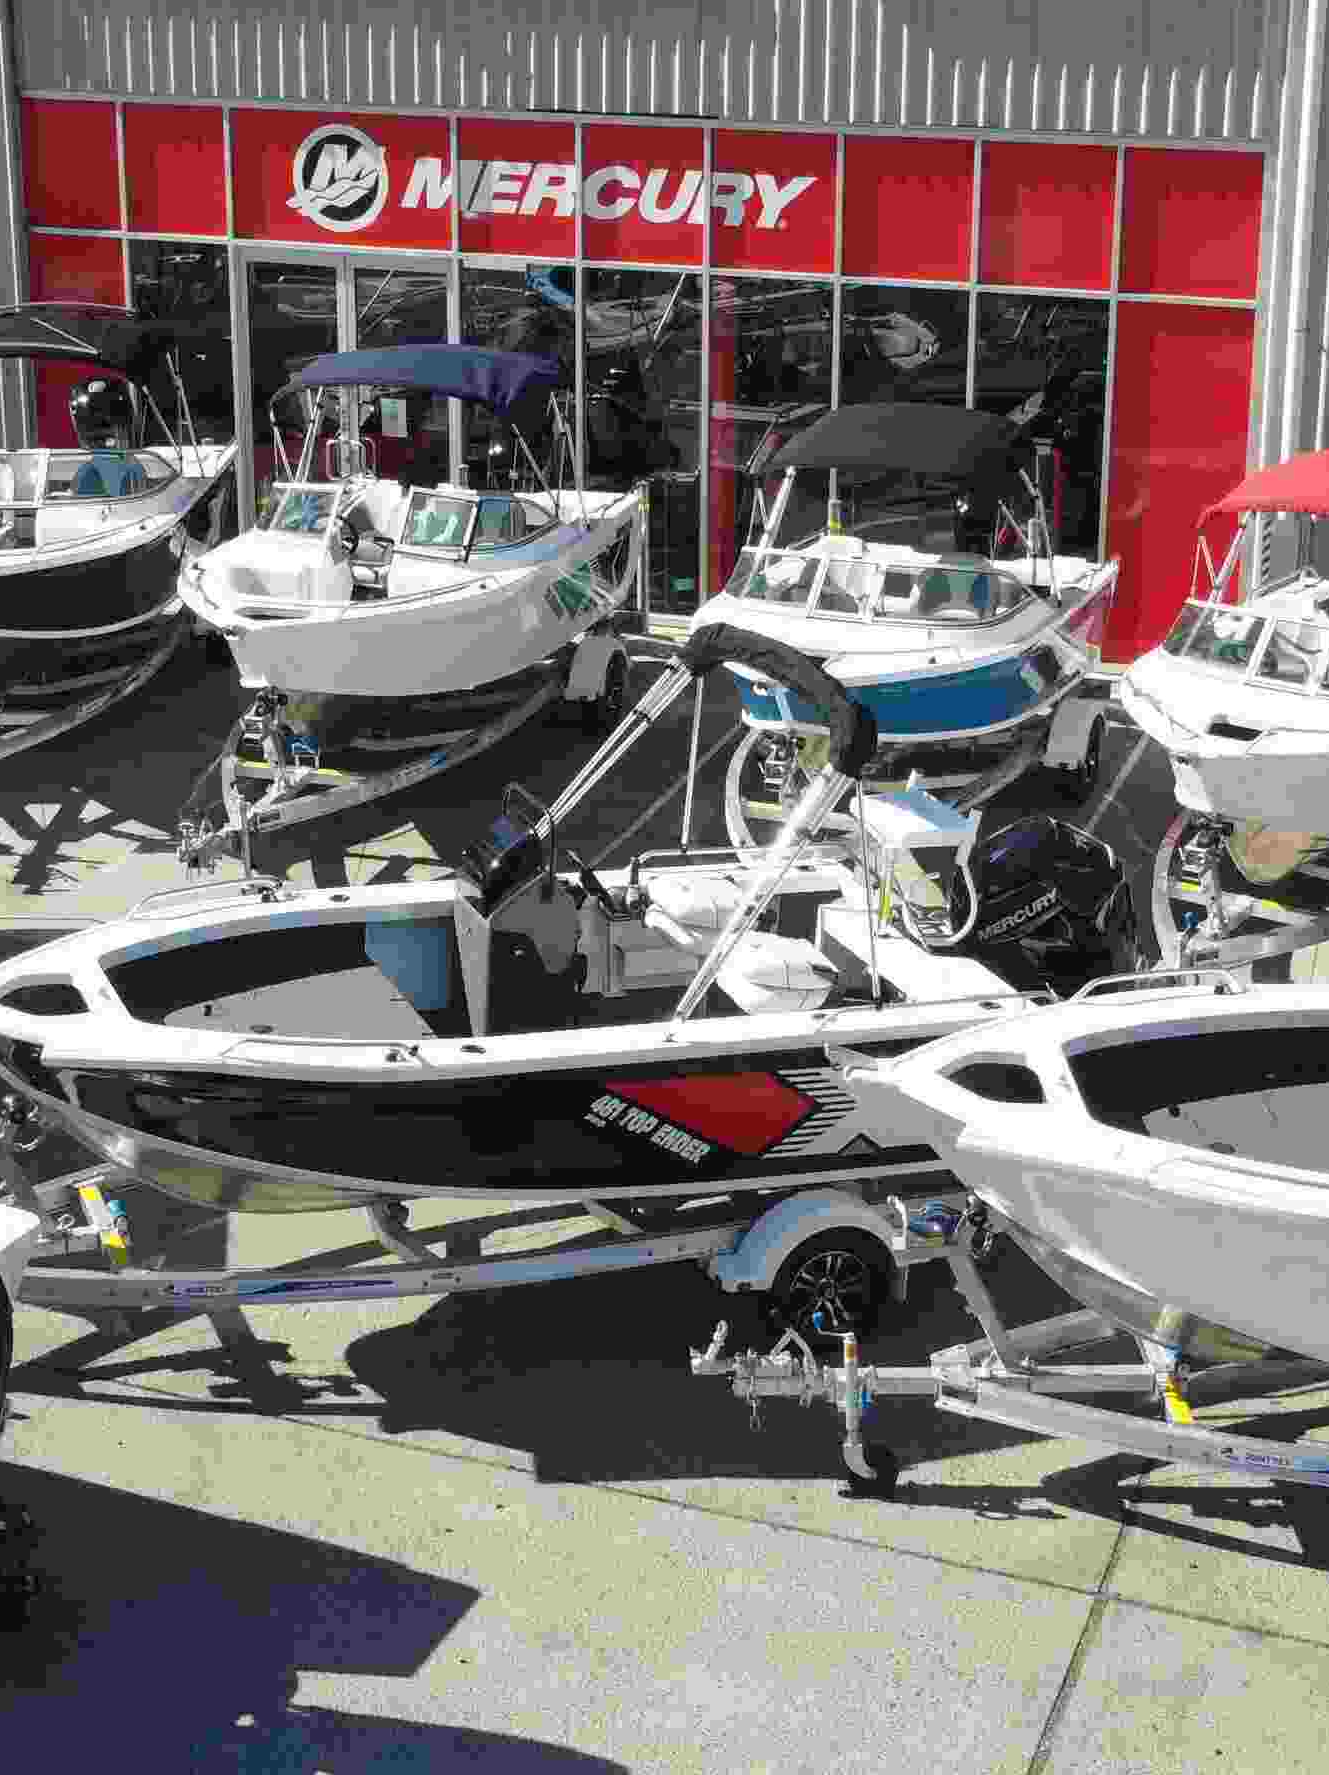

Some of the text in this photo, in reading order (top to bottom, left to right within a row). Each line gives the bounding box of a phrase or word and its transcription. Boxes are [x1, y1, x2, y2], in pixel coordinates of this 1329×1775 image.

[401, 155, 818, 231] MERCURY
[978, 888, 1057, 941] MERCURY
[619, 1106, 659, 1134] TOP
[651, 1123, 711, 1163] ENDER
